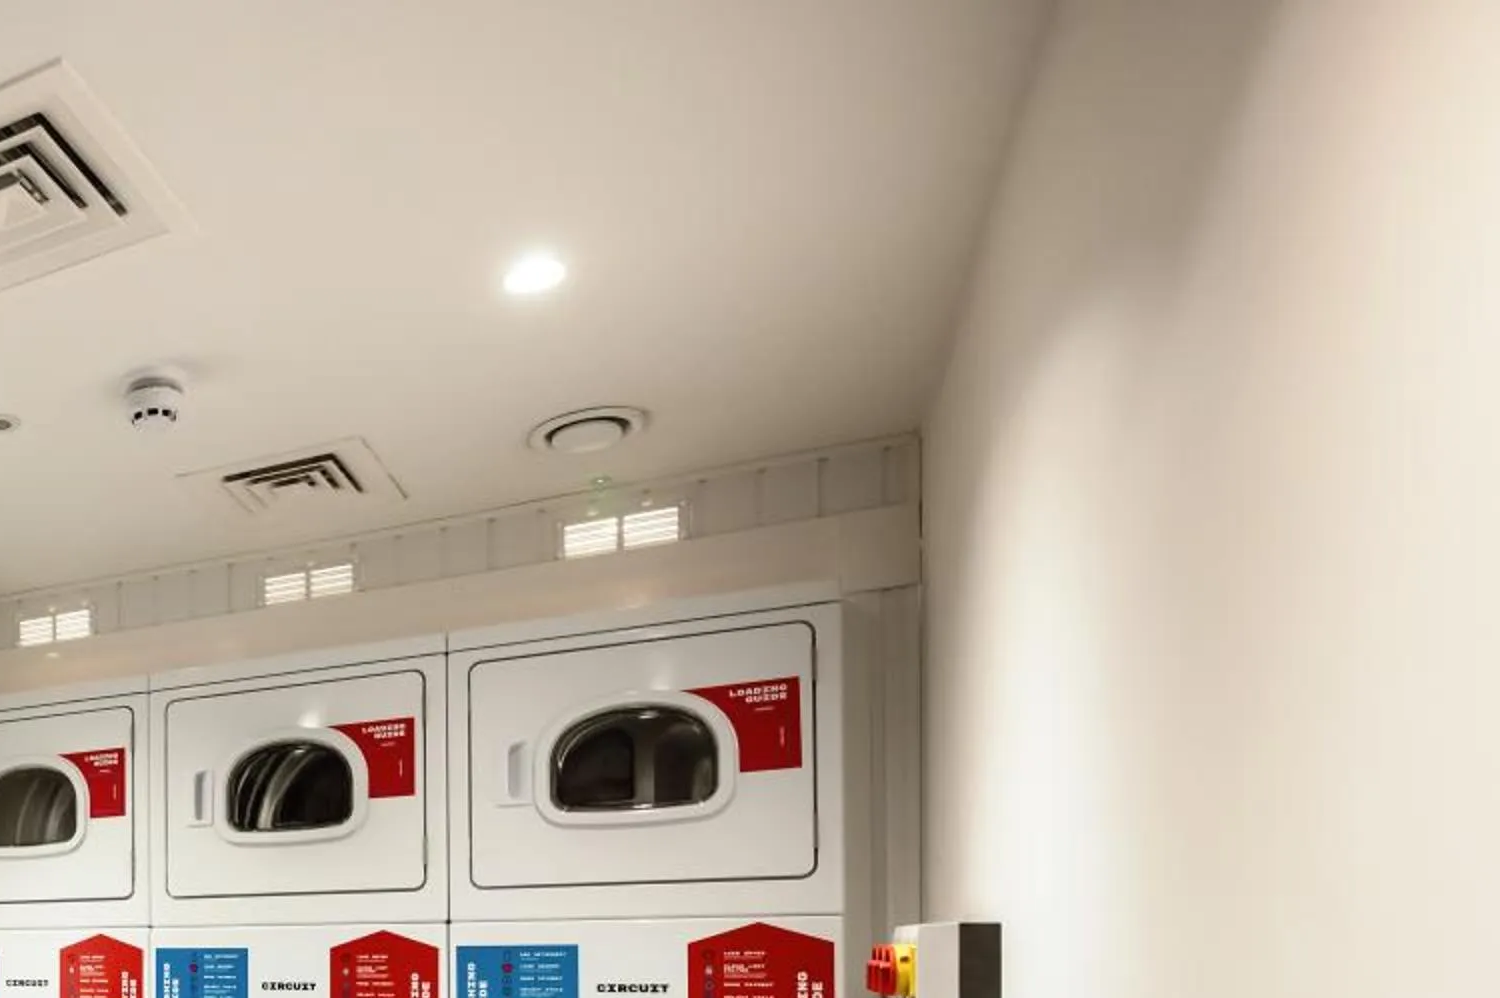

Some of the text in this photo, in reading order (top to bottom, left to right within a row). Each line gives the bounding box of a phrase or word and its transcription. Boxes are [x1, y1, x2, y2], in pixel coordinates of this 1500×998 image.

[728, 683, 788, 698] LOADING
[5, 979, 49, 987] CIRCUIT
[261, 981, 317, 991] CIRCUIT
[596, 982, 670, 993] CIRCUIT
